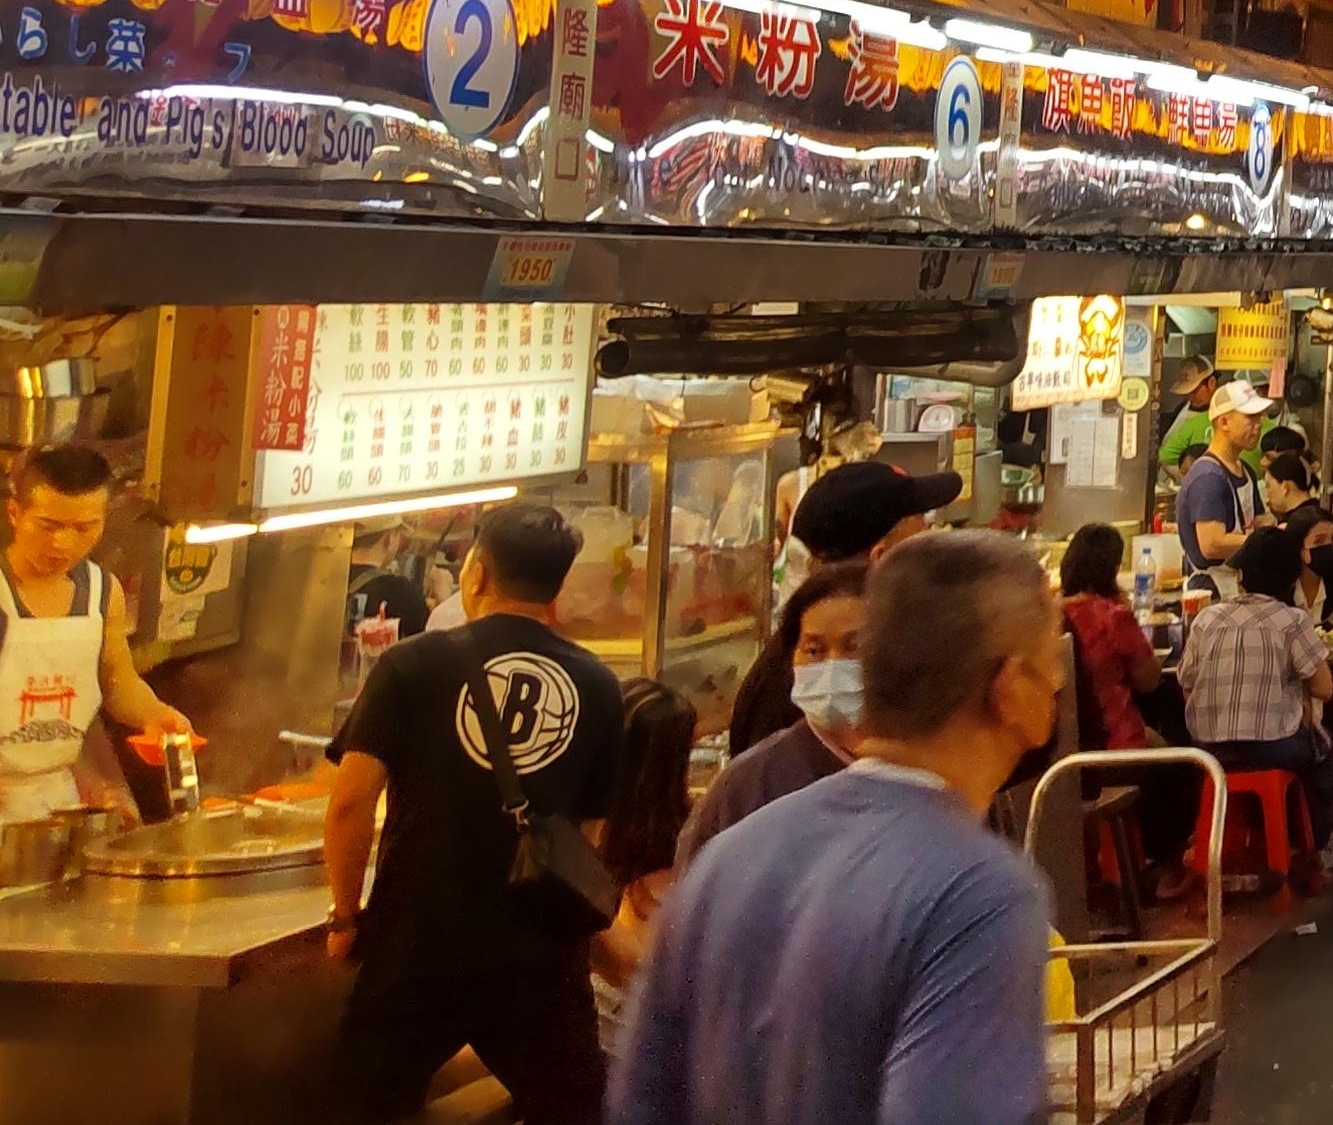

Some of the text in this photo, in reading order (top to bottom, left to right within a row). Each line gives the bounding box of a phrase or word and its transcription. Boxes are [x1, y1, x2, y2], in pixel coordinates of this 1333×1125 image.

[97, 91, 152, 145] and
[239, 101, 310, 161] Blood
[321, 109, 377, 169] Soup
[947, 82, 973, 148] 6
[510, 257, 554, 282] 1950
[290, 465, 313, 497] 30
